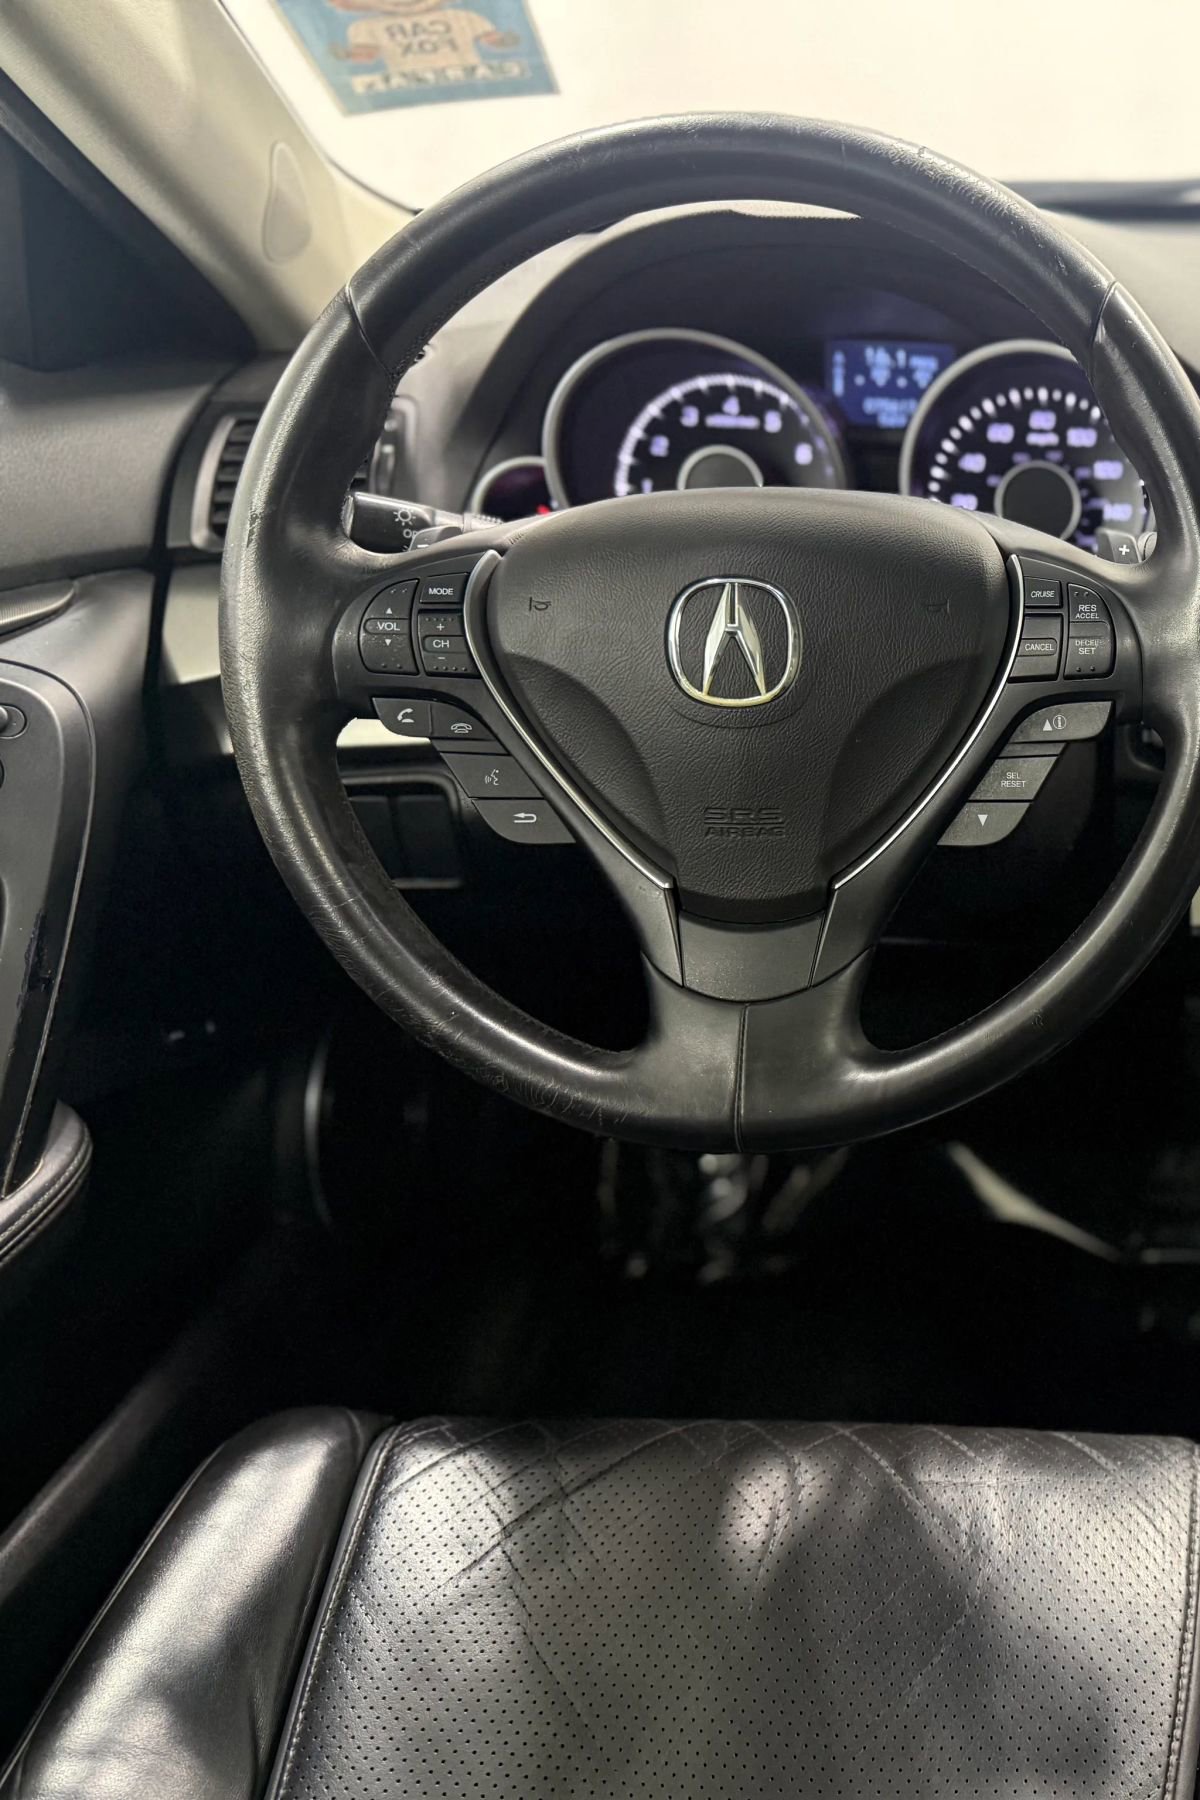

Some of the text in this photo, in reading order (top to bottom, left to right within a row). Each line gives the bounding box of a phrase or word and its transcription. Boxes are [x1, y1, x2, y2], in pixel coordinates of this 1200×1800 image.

[680, 405, 699, 427] 3
[428, 587, 454, 596] MODE
[1030, 589, 1055, 598] CRUISE
[1077, 604, 1097, 612] RES
[378, 622, 401, 632] VOL
[433, 639, 450, 649] CH
[1024, 643, 1054, 652] CANCEL
[1078, 647, 1096, 655] SET
[1006, 772, 1021, 780] SEL
[1000, 780, 1026, 788] RESET
